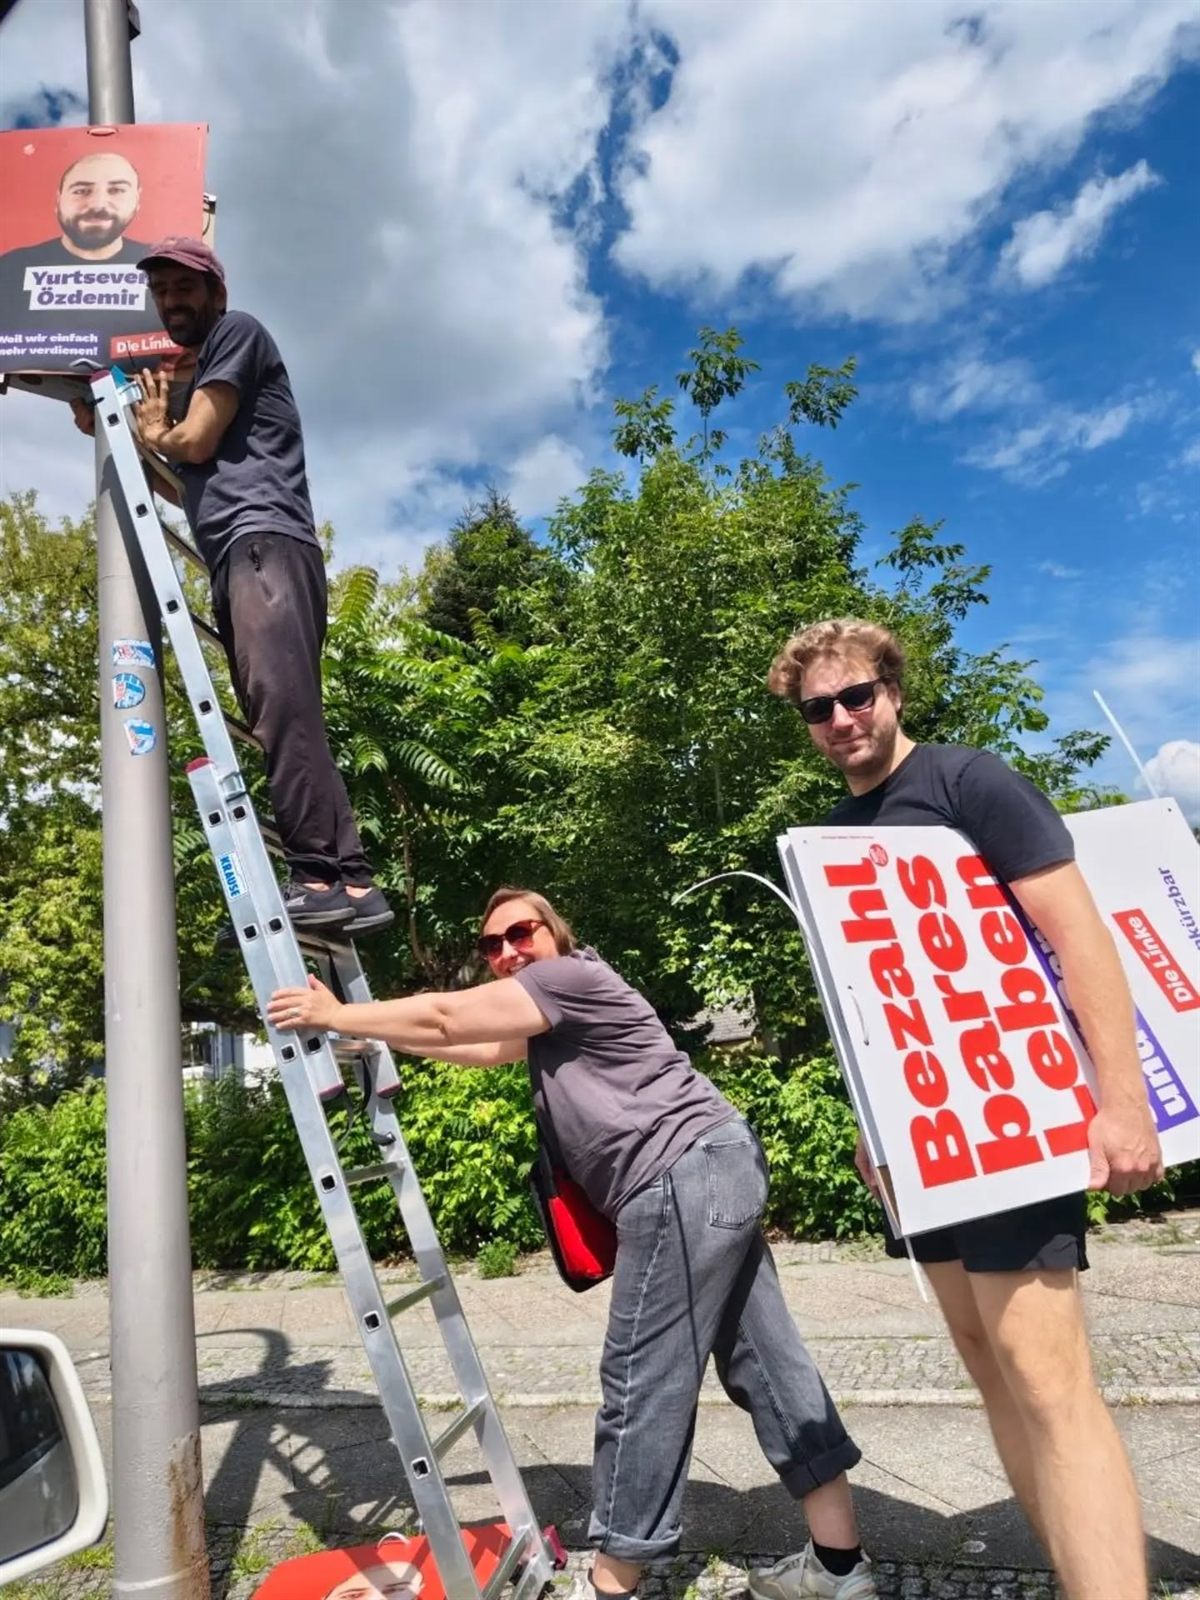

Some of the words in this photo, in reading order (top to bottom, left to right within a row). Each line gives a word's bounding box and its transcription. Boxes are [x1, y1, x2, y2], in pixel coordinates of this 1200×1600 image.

[37, 287, 139, 305] Özdemir
[25, 333, 47, 342] wir
[49, 333, 98, 343] einfach
[29, 345, 98, 356] verdienen!
[117, 341, 138, 353] Die
[220, 856, 240, 896] KRAUSE
[1128, 916, 1171, 968] Linke
[1164, 969, 1195, 1003] Die
[823, 857, 977, 1189] Bezahl
[897, 855, 1045, 1175] bares
[956, 854, 1098, 1157] Leben
